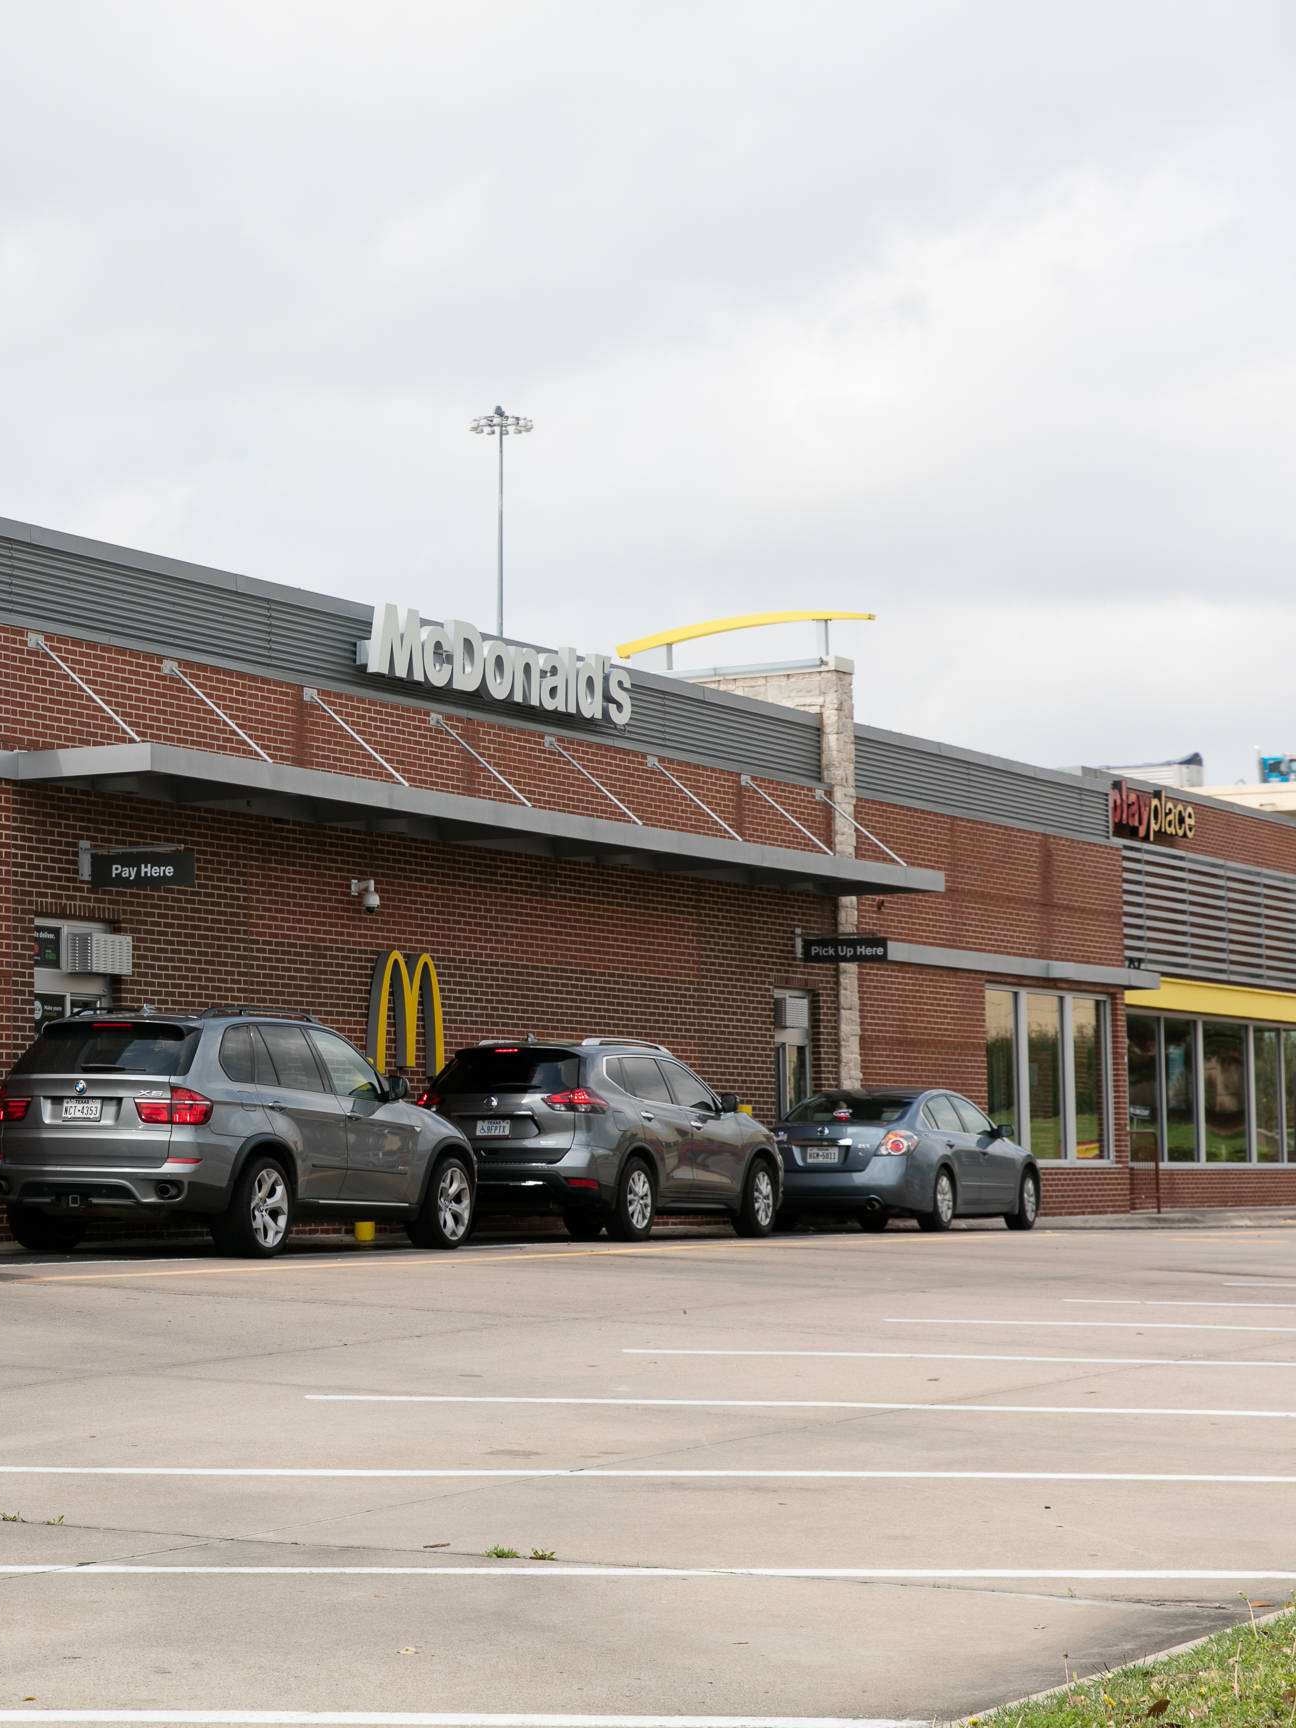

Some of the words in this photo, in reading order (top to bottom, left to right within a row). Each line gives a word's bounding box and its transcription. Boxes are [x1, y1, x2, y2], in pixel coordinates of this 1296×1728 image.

[368, 602, 632, 725] McDonald's
[111, 864, 137, 880] Pay
[140, 863, 174, 877] Here
[811, 946, 835, 957] Pick
[838, 946, 854, 958] Up
[856, 945, 884, 956] Here
